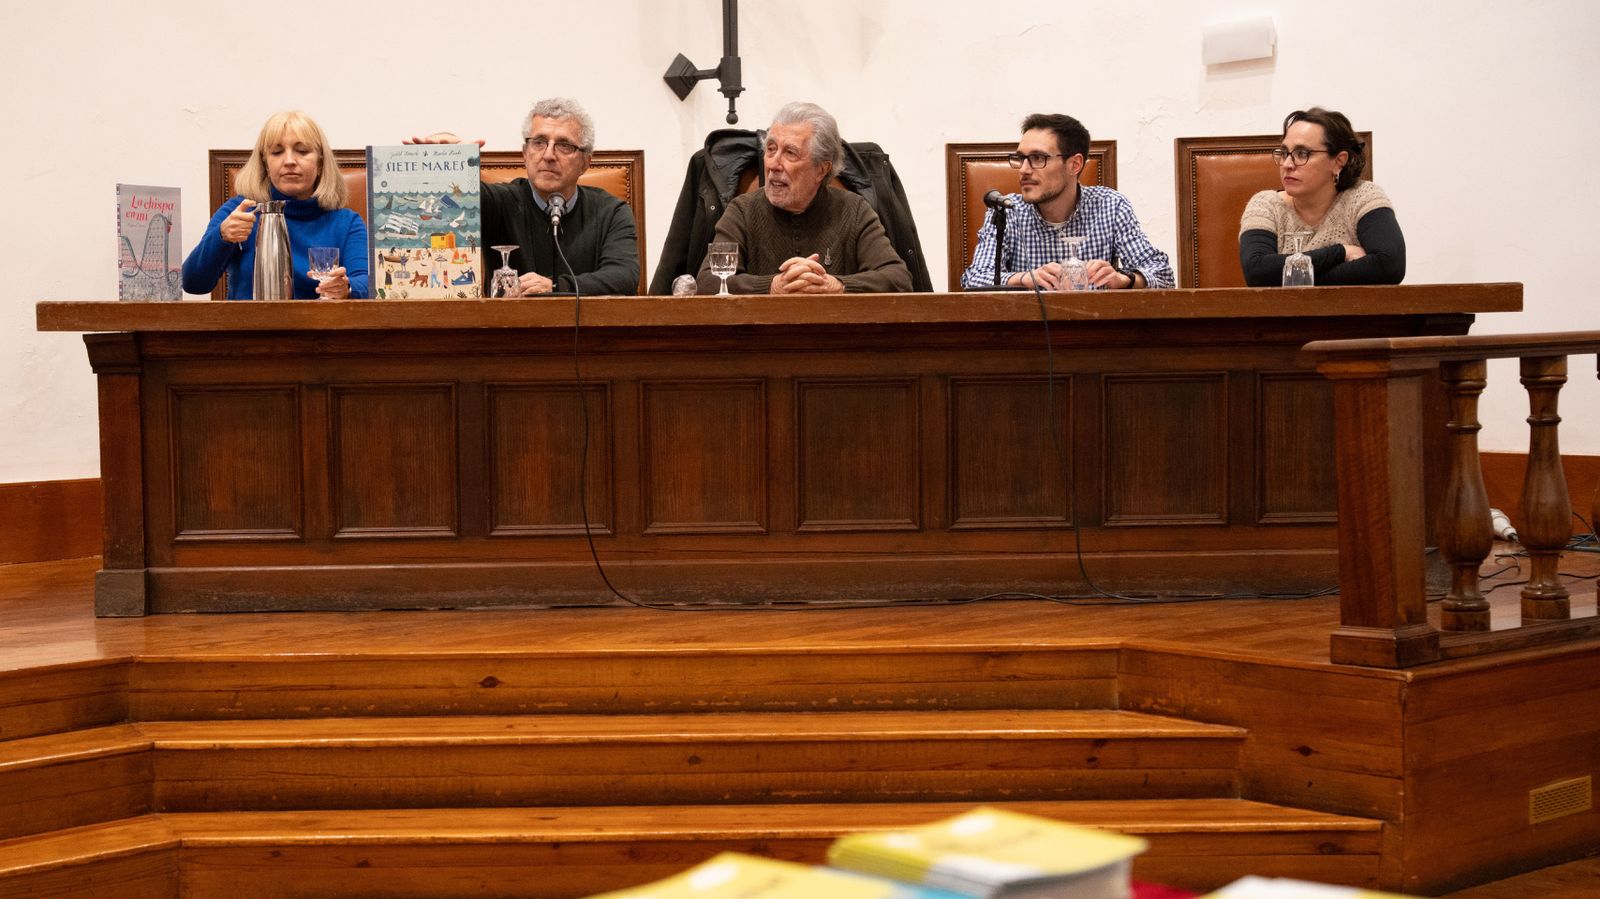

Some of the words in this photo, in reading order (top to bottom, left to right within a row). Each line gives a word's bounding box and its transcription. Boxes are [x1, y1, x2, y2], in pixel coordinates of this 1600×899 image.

[386, 161, 418, 172] SIETE
[422, 160, 466, 172] MARES
[131, 195, 143, 209] La
[143, 196, 175, 214] chispa
[125, 211, 136, 219] en
